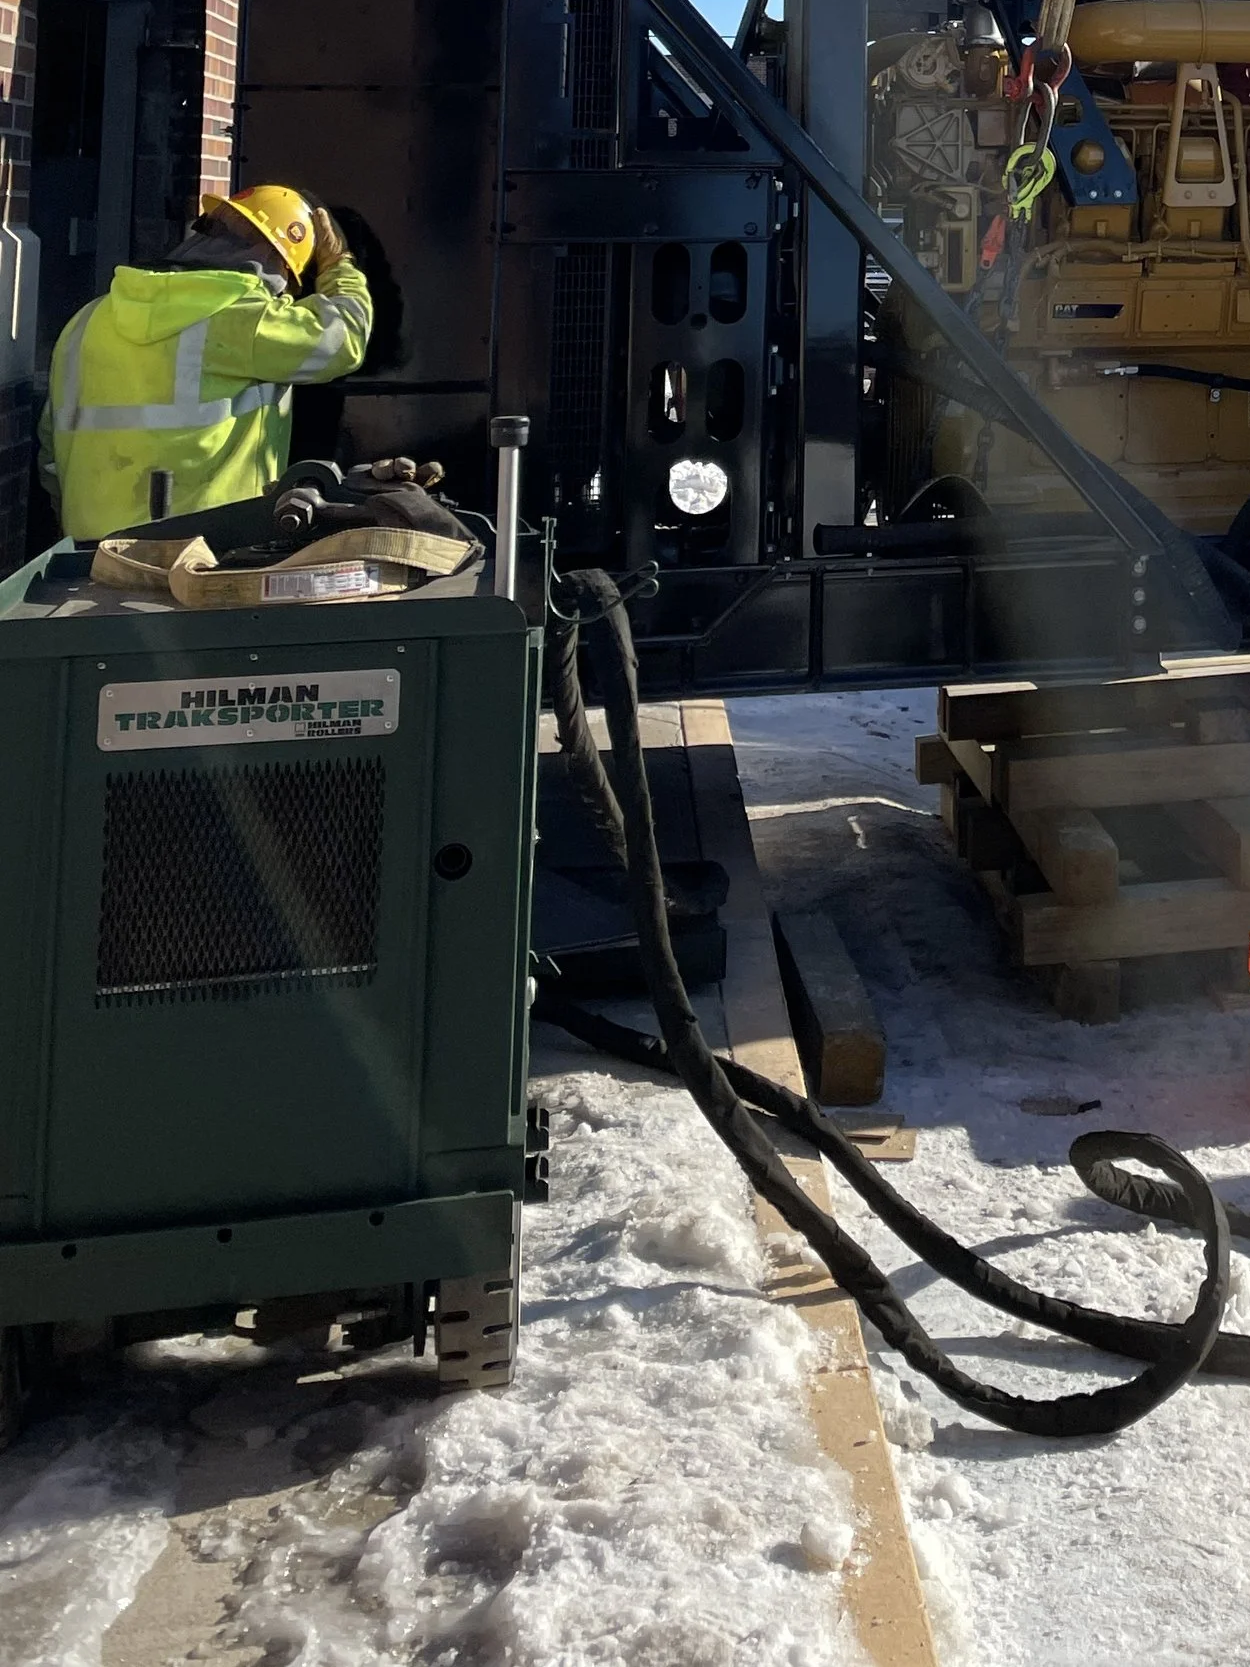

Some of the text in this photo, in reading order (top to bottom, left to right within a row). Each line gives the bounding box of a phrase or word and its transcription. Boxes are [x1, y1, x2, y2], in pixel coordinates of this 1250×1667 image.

[1055, 304, 1079, 318] CAT
[181, 684, 319, 709] HILMAN
[115, 699, 384, 731] TRAKSPORTER
[307, 719, 362, 729] HILMAN
[307, 727, 362, 737] ROLLERS
